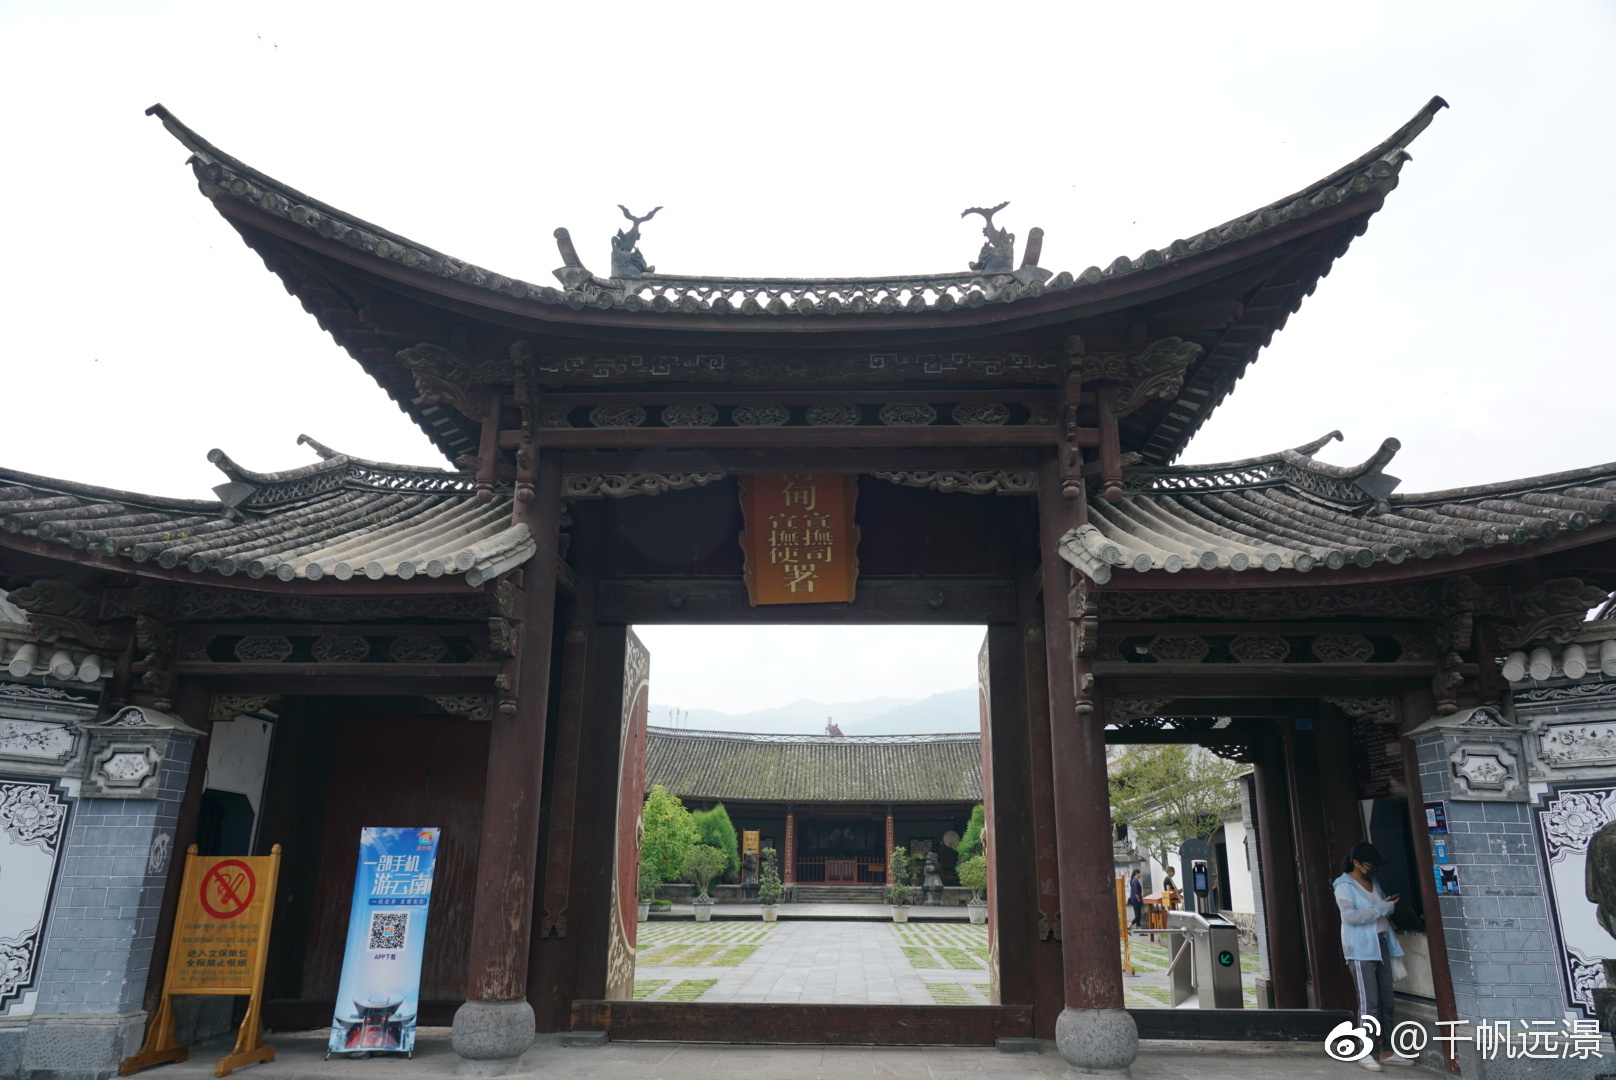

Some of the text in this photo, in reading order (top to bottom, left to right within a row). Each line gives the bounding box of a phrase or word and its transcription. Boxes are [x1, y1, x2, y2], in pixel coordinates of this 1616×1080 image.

[364, 854, 420, 872] 一部手机
[370, 872, 430, 896] 游云南
[188, 950, 248, 958] 进入文保单位
